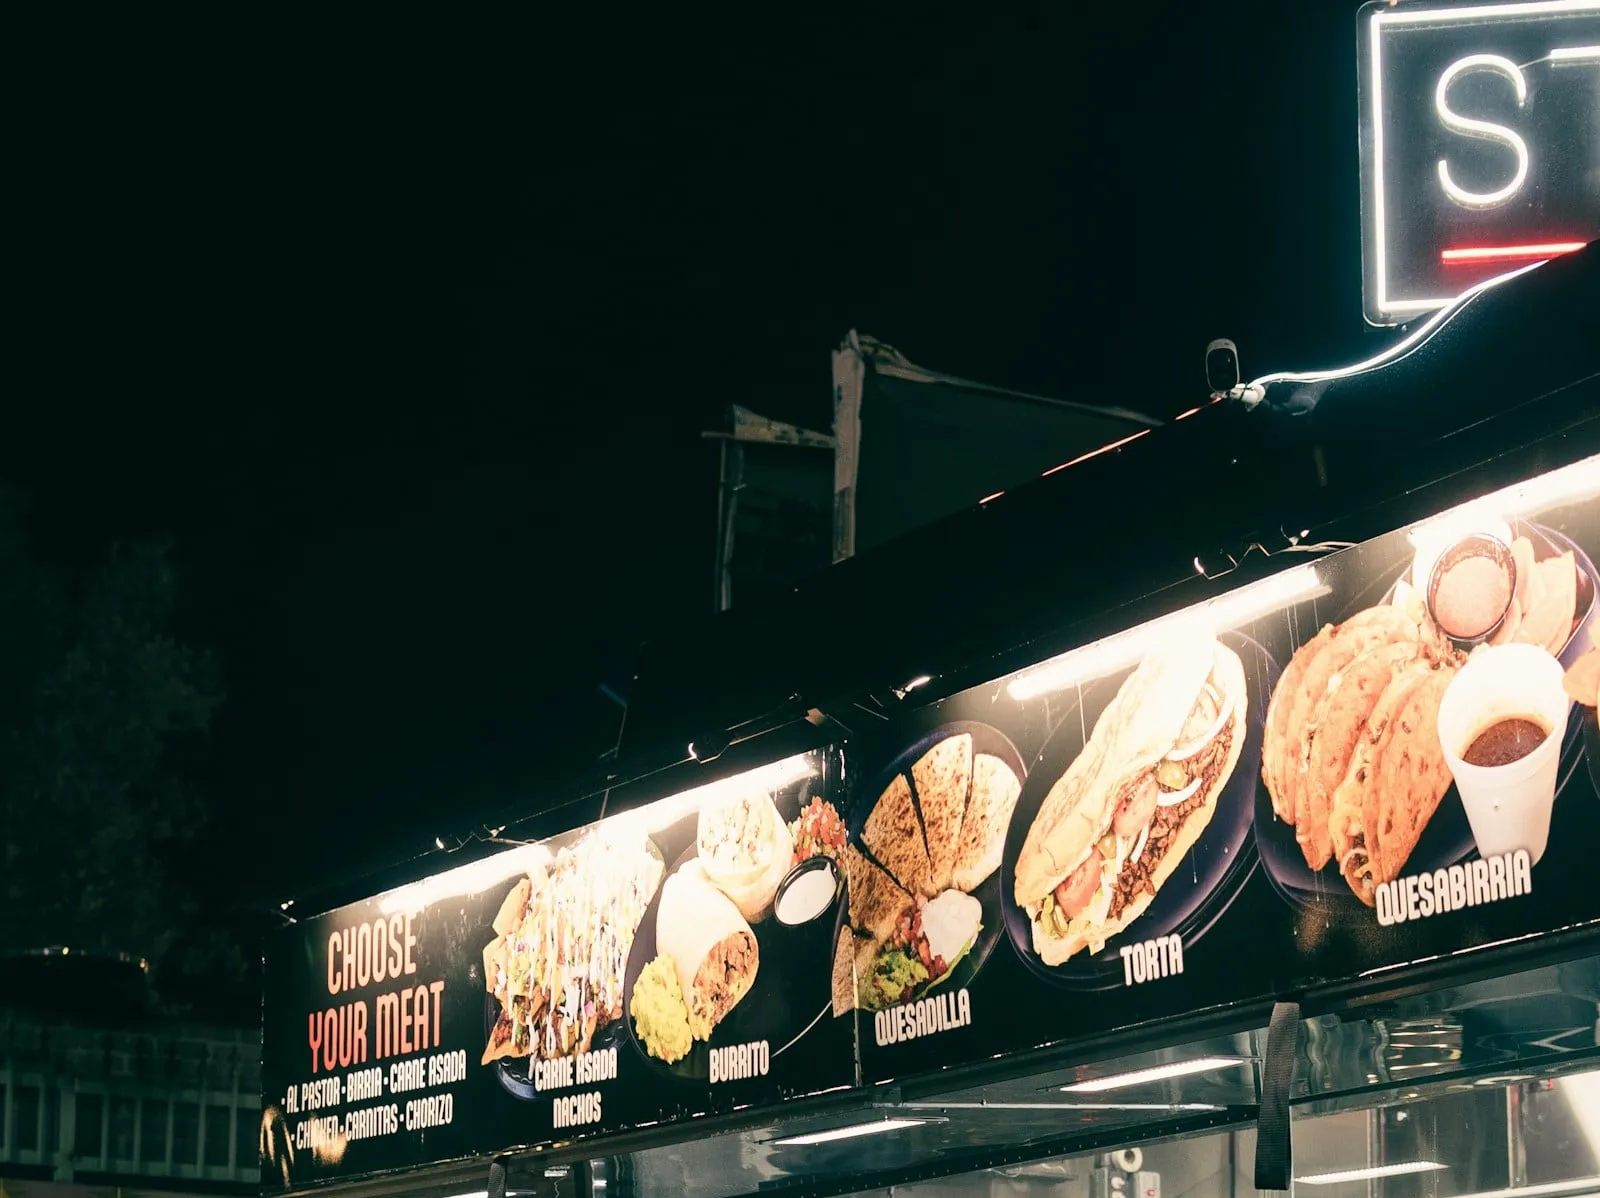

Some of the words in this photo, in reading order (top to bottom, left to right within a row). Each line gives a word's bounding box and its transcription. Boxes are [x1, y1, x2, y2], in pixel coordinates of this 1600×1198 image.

[1375, 848, 1533, 927] QUESABIRRIA
[327, 912, 417, 995] CHOOSE
[1120, 932, 1184, 987] TORTA
[308, 1000, 368, 1073] YOUR
[375, 980, 445, 1060] MEAT
[874, 988, 971, 1047] QUESADILLA
[286, 1085, 299, 1113] AL
[301, 1076, 341, 1112] PASTOR
[346, 1066, 382, 1103] BIRRIA
[389, 1057, 426, 1094] CARNE
[428, 1049, 466, 1087] ASADA
[534, 1055, 574, 1092] CARNE
[576, 1047, 618, 1084] ASADA
[709, 1039, 770, 1084] BURRITO
[344, 1102, 398, 1141] CARNITAS
[405, 1093, 453, 1131] CHORIZO
[552, 1091, 602, 1129] NACHOS
